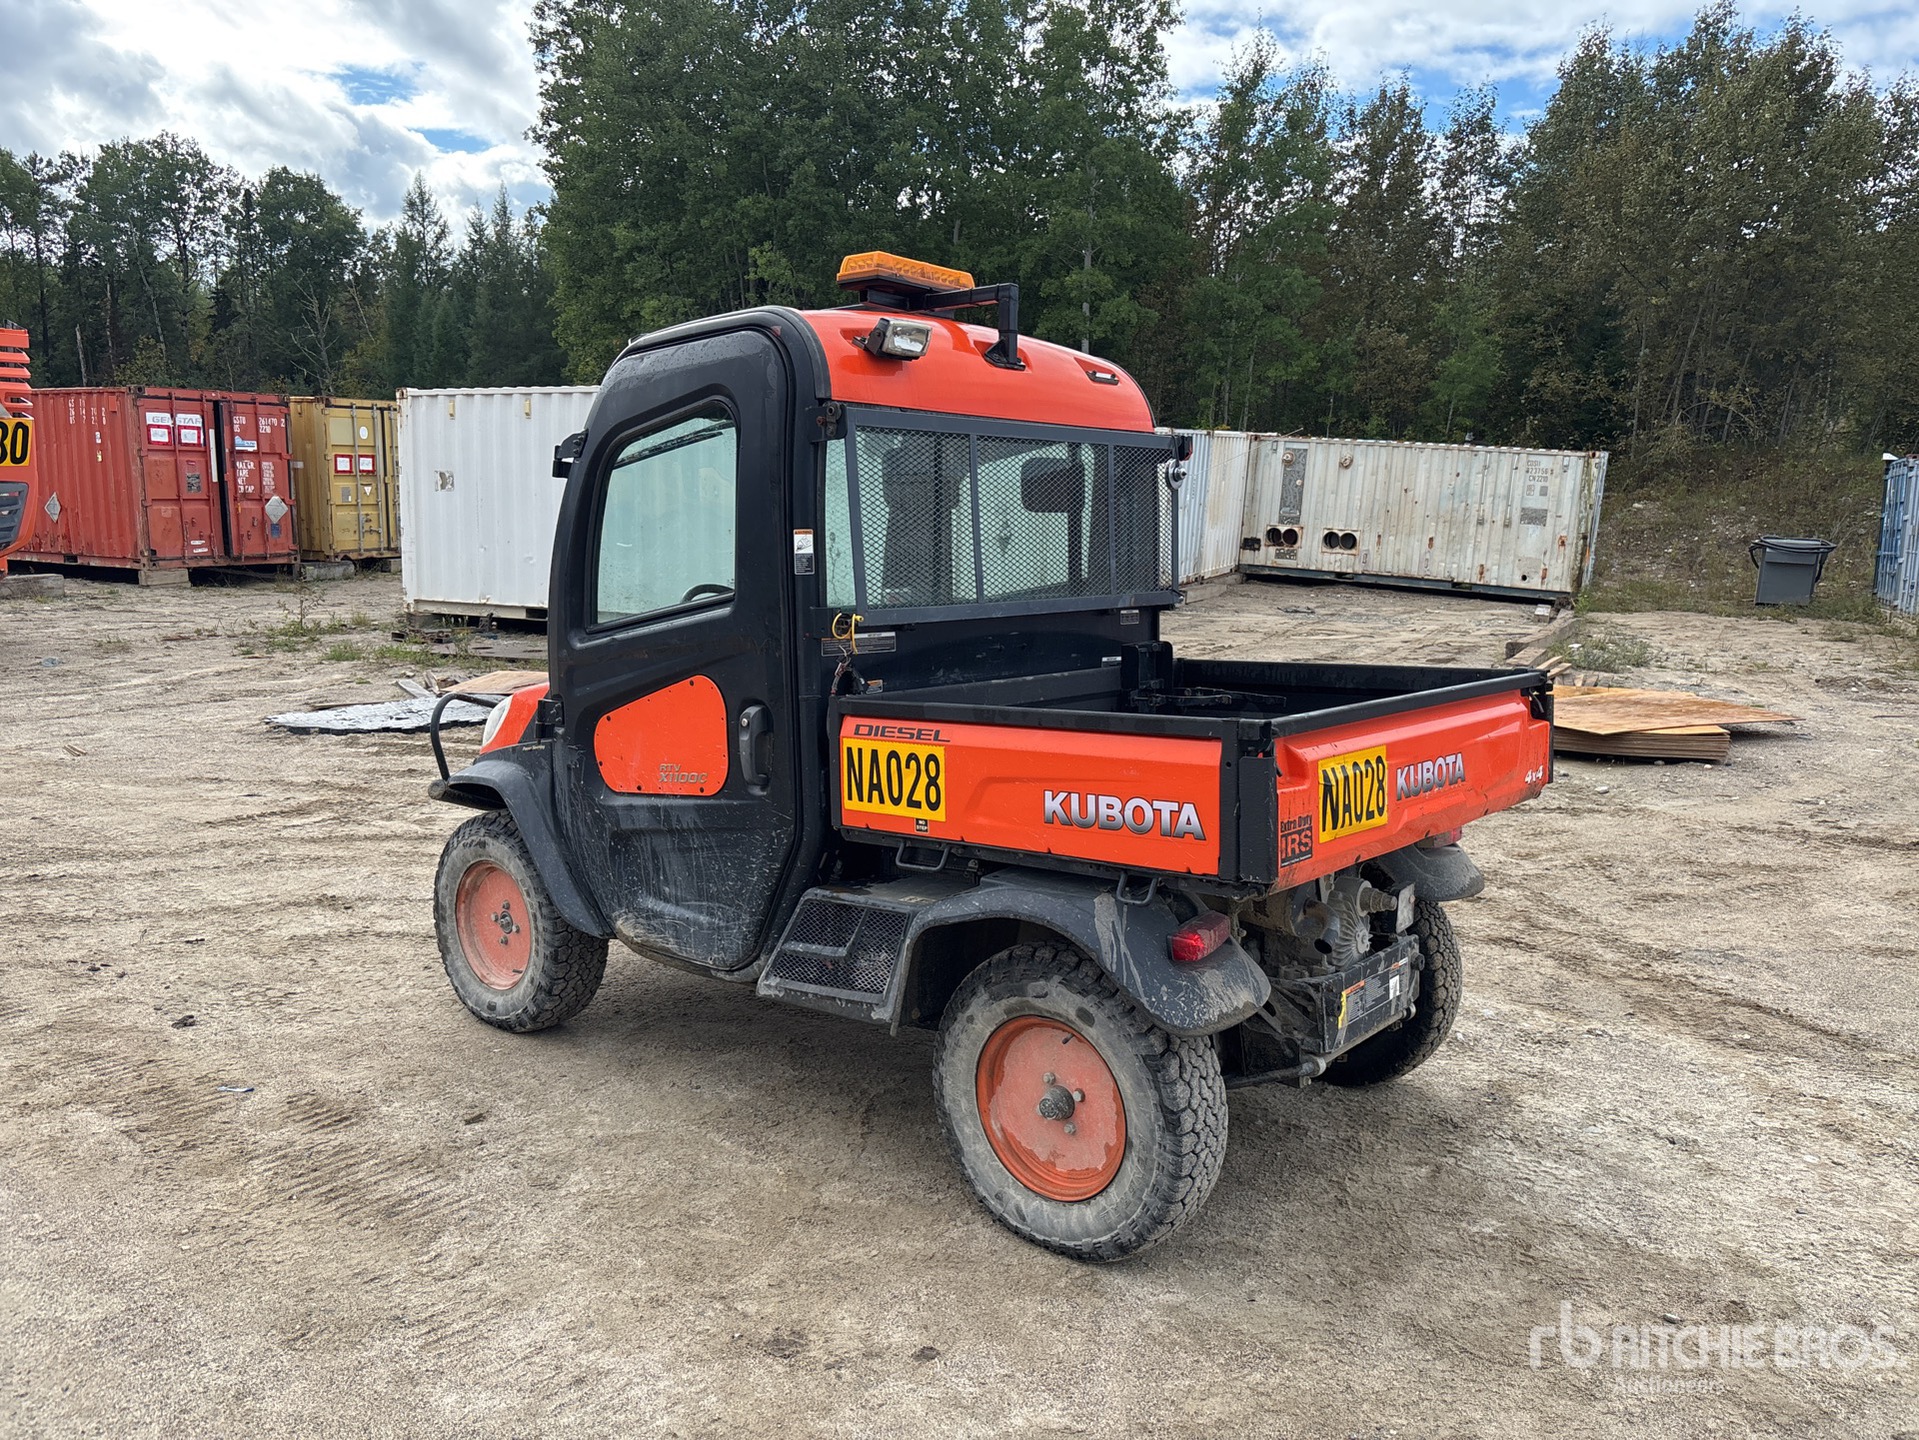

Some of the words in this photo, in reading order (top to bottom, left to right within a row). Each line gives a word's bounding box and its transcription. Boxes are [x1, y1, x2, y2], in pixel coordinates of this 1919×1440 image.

[854, 723, 951, 743] DIESEL
[659, 763, 681, 772] RTV
[846, 746, 942, 812] NA028
[1396, 753, 1467, 801] KUBOTA
[1043, 788, 1207, 842] KUBOTA
[1321, 754, 1386, 833] NA028
[1281, 829, 1312, 860] IRS
